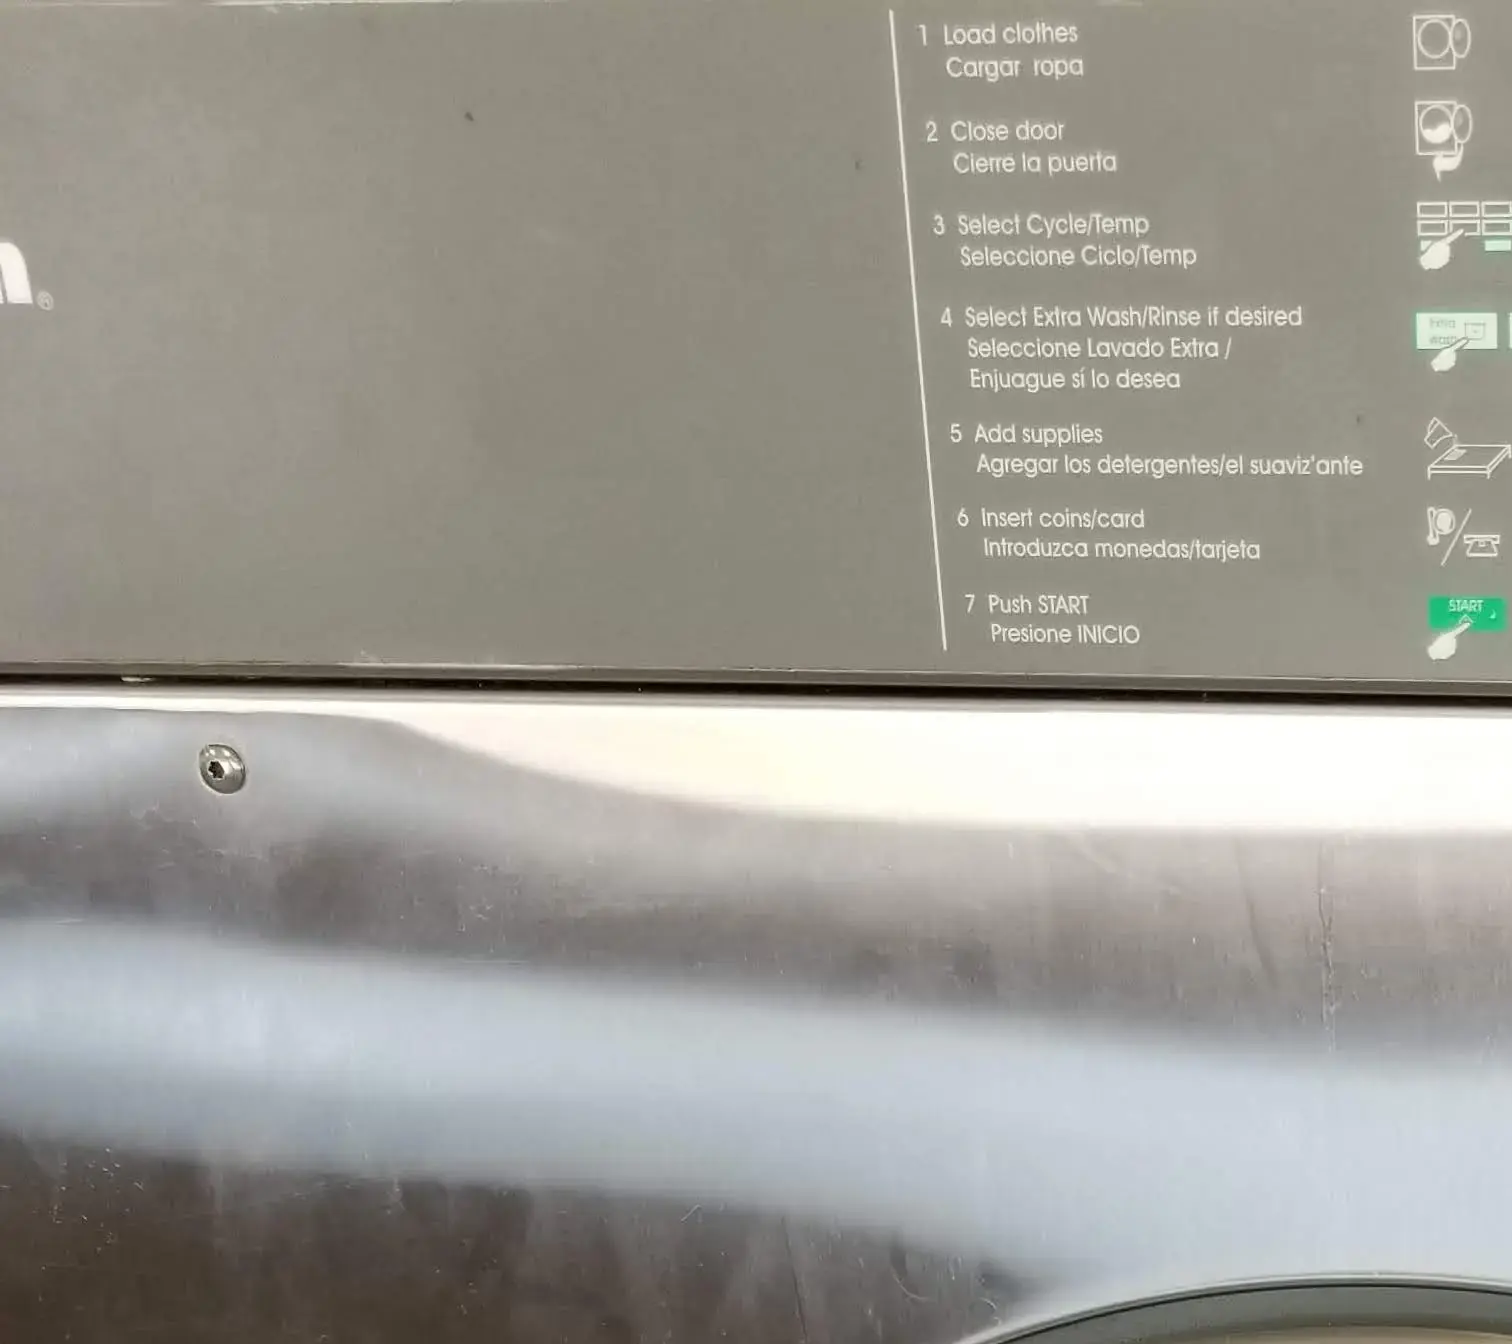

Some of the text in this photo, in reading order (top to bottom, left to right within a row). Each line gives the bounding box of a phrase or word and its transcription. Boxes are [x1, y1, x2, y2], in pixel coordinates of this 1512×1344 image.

[919, 22, 1078, 45] 1 Load clothes
[946, 57, 1083, 82] Cargar ropa
[926, 120, 1064, 142] 2 Close door
[954, 151, 1117, 176] Cierre la puerta
[934, 212, 1149, 238] 3 Select Cycle/Temp
[961, 244, 1196, 269] Seleccione Ciclo/Temp
[941, 305, 1302, 328] 4 Select Extra Wash/Rinse if desired
[968, 337, 1081, 357] Seleccione
[1087, 337, 1164, 357] Lavado
[1170, 337, 1218, 357] Extra
[970, 368, 1065, 393] Enjuague
[1092, 369, 1109, 388] lo
[1116, 369, 1180, 388] desea
[951, 423, 1102, 447] 5 Add supplies
[977, 454, 1058, 478] Agregar
[1065, 454, 1091, 473] los
[1098, 454, 1243, 478] detergentes/el
[957, 508, 1144, 529] 6 Insert coins/card
[984, 538, 1260, 562] Introduzca monedas/tarjeta
[965, 594, 1089, 614] 7 Push START
[1449, 600, 1484, 612] START
[991, 624, 1140, 644] Presione INICIO
